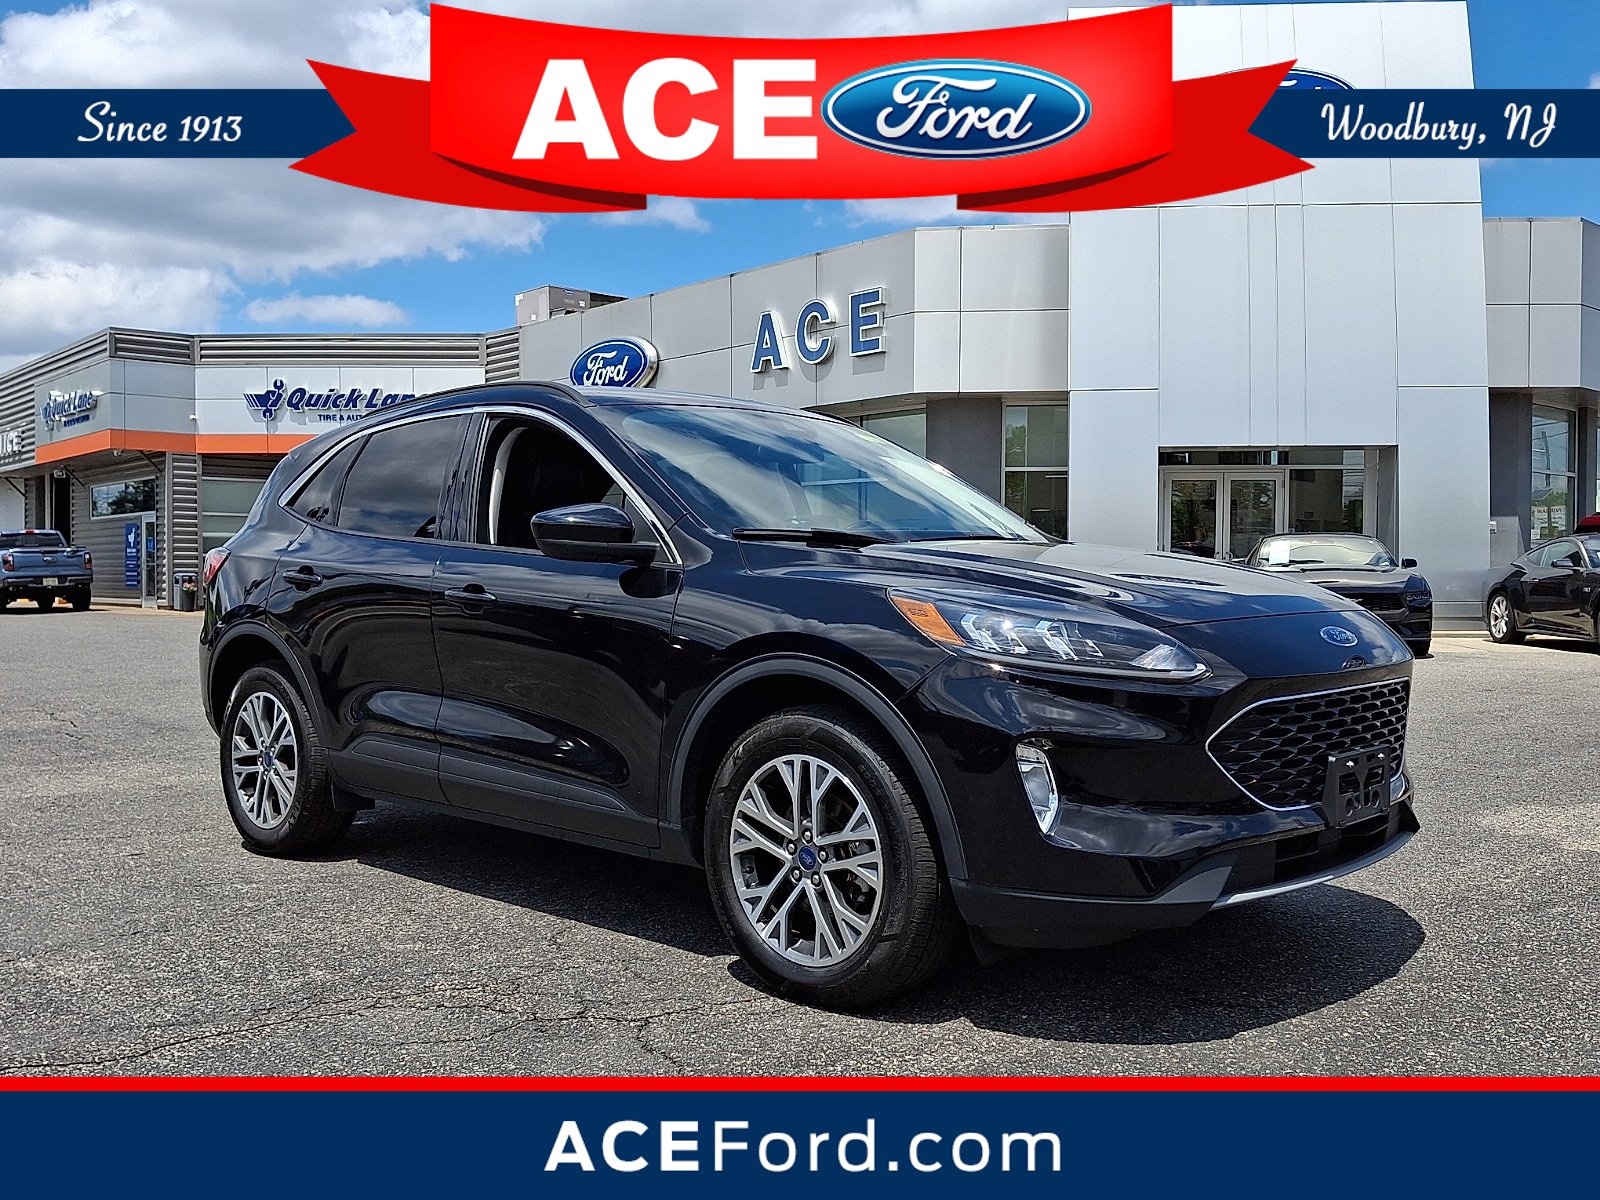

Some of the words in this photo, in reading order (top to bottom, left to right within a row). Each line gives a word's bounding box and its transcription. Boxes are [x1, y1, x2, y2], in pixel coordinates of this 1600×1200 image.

[751, 287, 888, 373] ACE
[583, 351, 628, 385] Ford
[73, 391, 93, 411] Lane
[286, 387, 363, 411] Quick
[364, 388, 416, 409] Lan
[317, 414, 338, 422] TIRE
